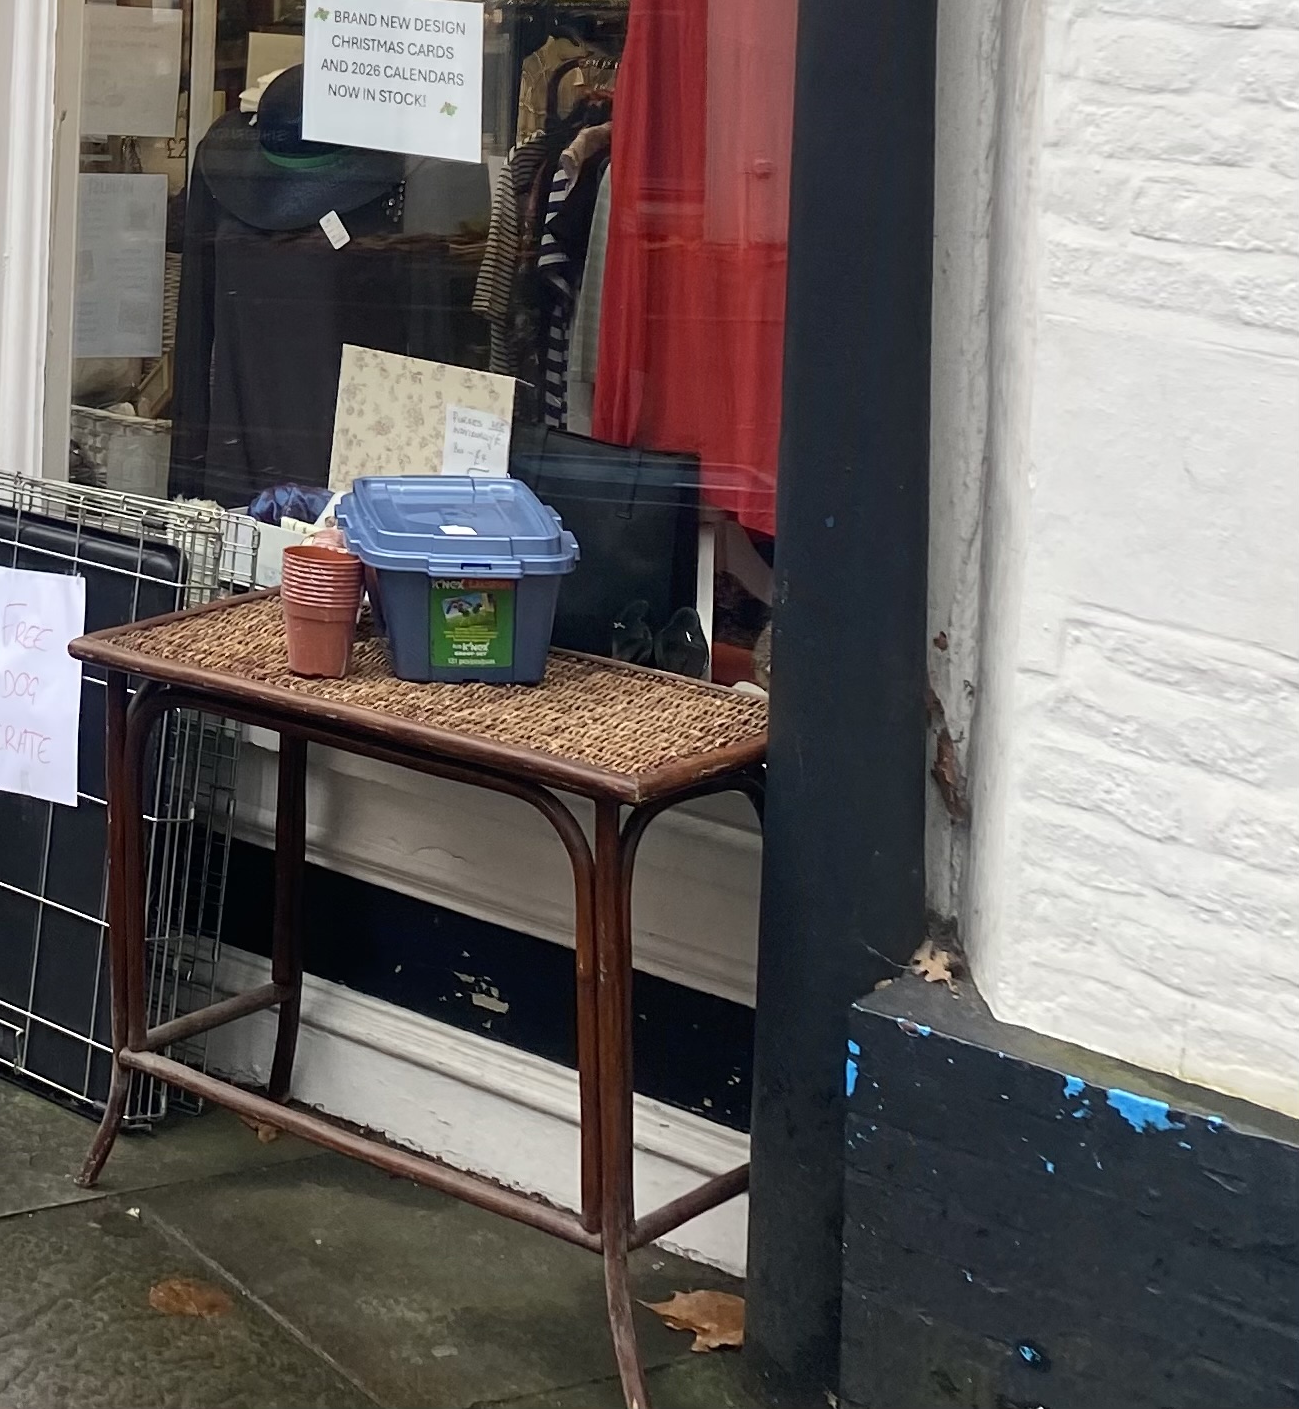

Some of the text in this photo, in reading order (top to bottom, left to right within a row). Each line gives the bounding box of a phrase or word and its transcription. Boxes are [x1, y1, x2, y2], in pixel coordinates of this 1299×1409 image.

[334, 10, 466, 35] BRAND NEW DESIGN
[332, 35, 454, 59] CHRISTMAS CARDS
[321, 58, 464, 86] AND 2026 CALENDARS
[328, 84, 427, 107] NOW IN STOCK!
[2, 603, 54, 652] FREE
[2, 669, 39, 705] DOG
